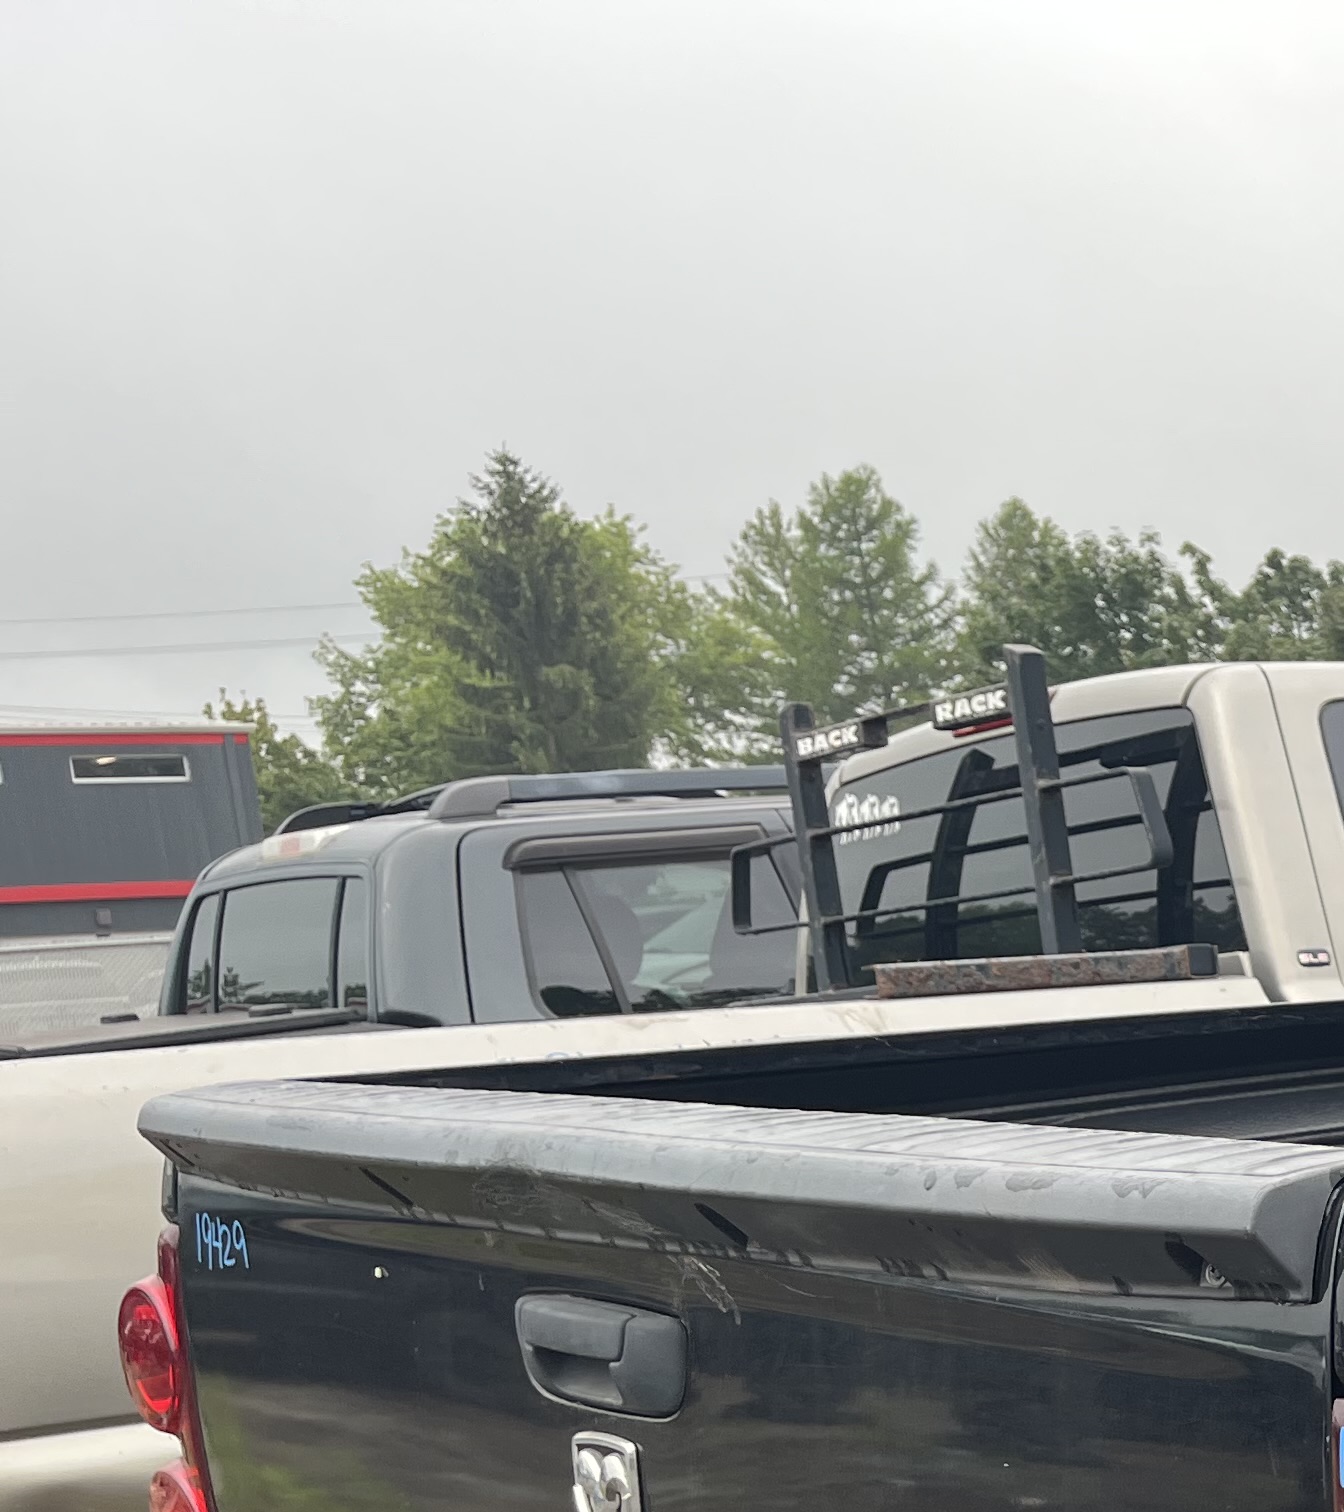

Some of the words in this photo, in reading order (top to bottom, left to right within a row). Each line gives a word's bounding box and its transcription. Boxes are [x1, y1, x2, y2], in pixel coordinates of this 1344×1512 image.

[796, 724, 860, 757] BACK
[933, 689, 1008, 723] RACK
[195, 1211, 250, 1272] 19429
